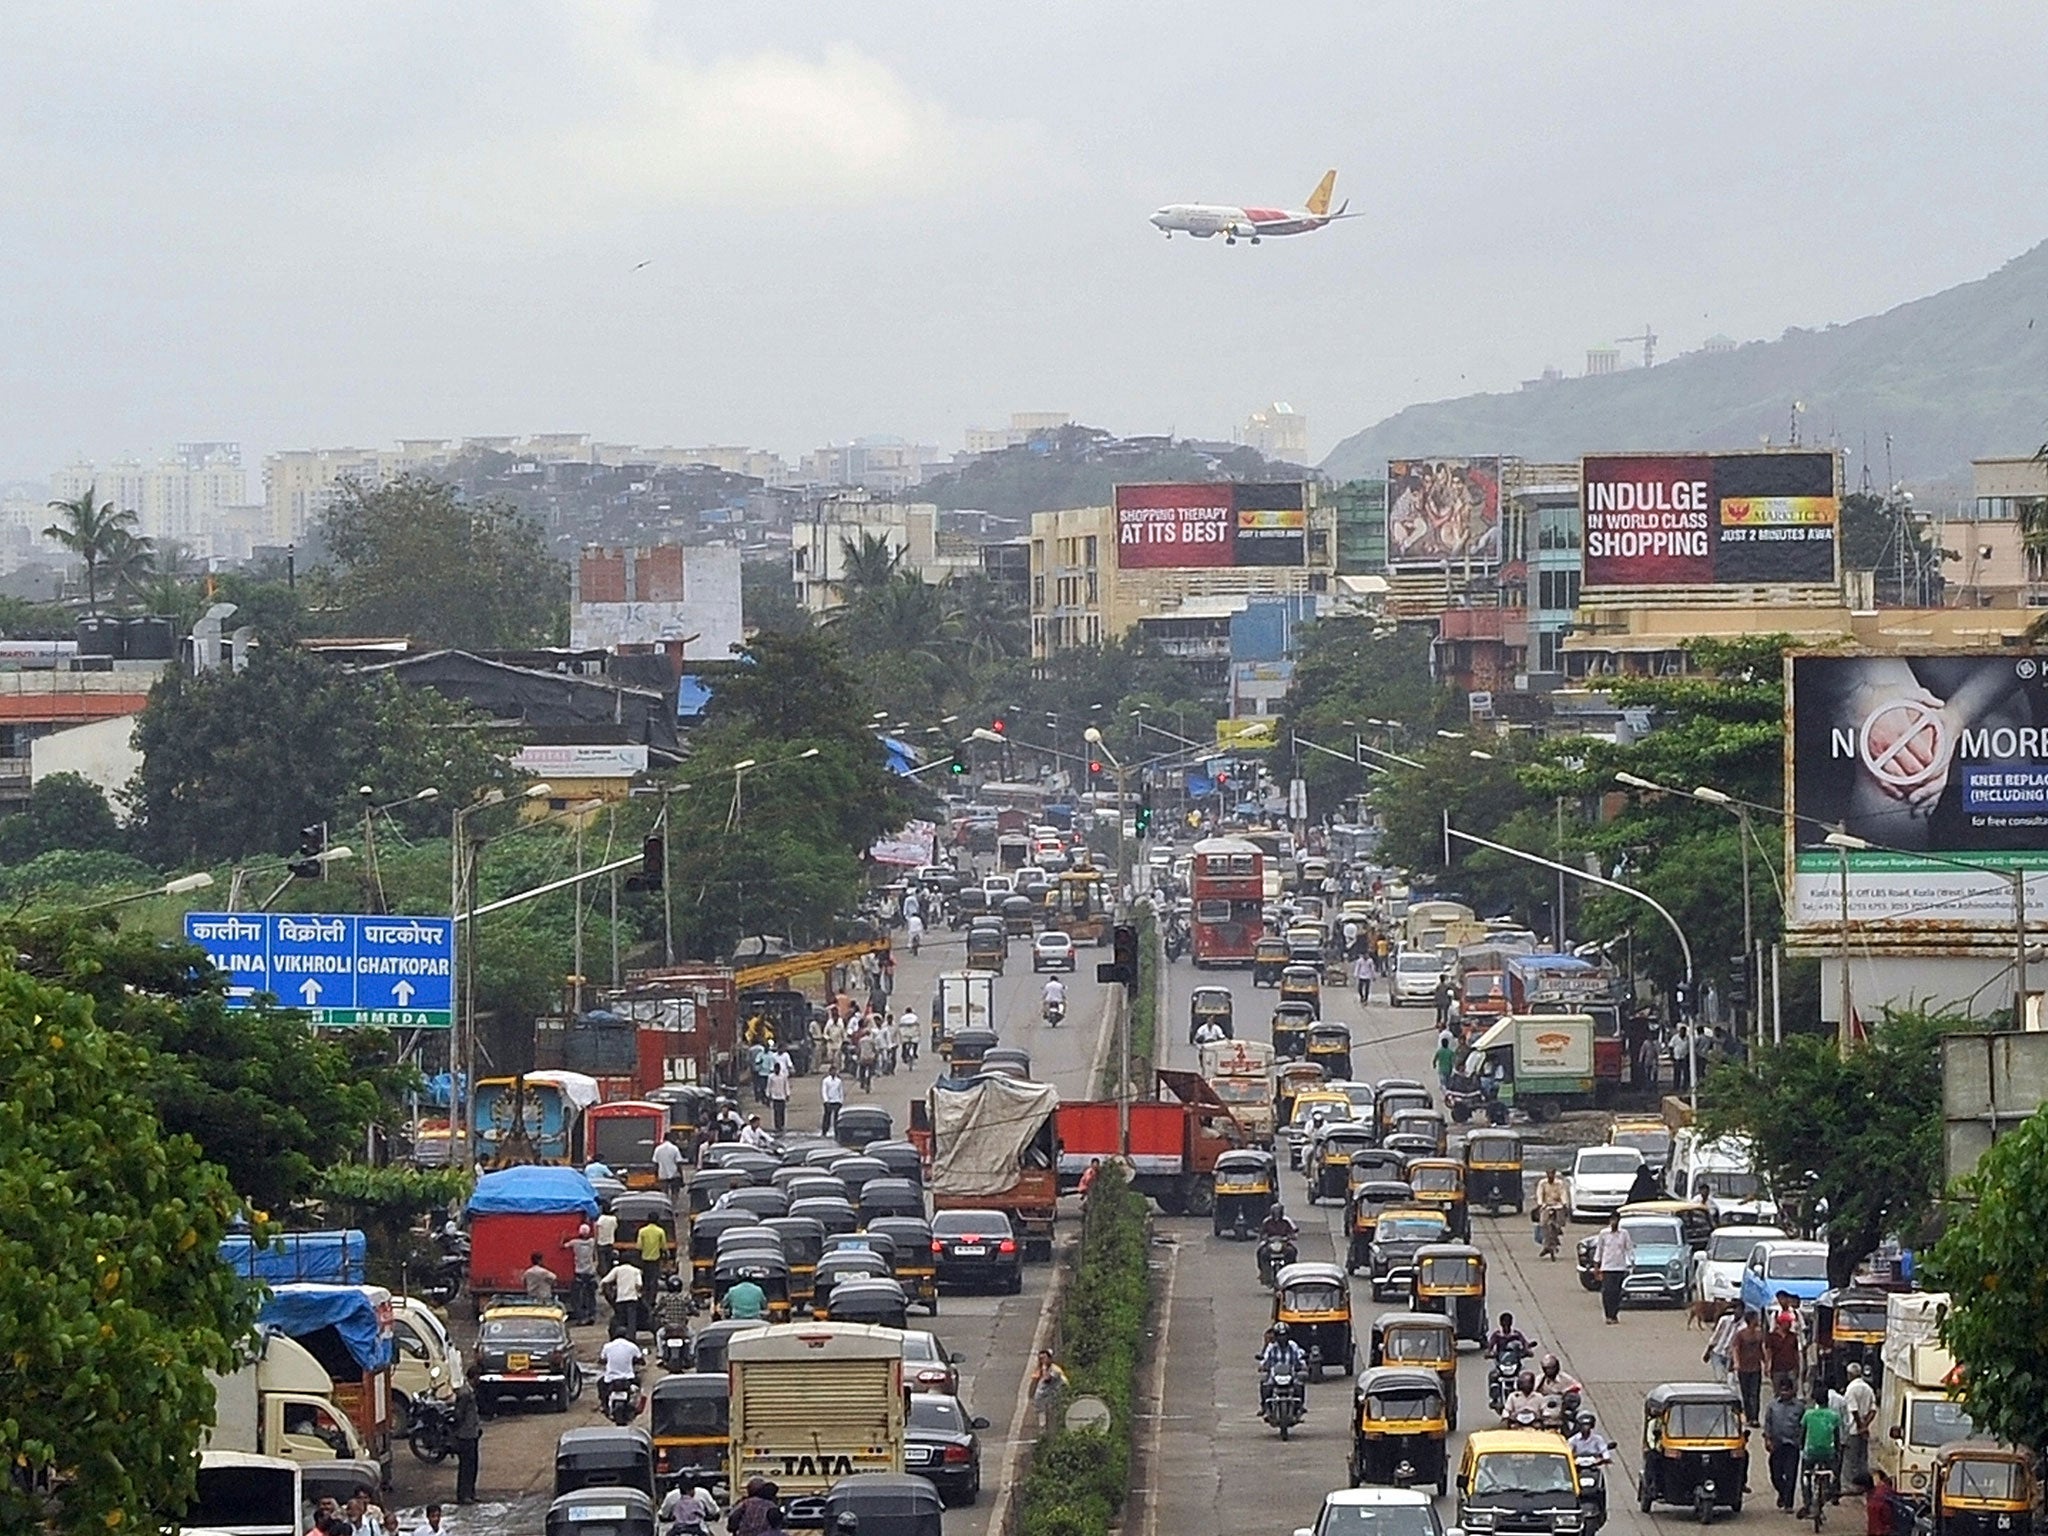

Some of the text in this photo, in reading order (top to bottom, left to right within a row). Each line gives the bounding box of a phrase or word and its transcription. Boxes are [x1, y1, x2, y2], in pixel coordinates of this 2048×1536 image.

[1588, 481, 1708, 511] INDULGE
[1588, 512, 1708, 529] IN WORLD CLASS
[1121, 522, 1228, 544] AT ITS BEST
[1720, 529, 1747, 541] JUST
[1749, 529, 1757, 540] 2
[1758, 529, 1805, 541] MINUTES
[1588, 531, 1708, 557] SHOPPING
[1970, 774, 2003, 787] KNEE
[1972, 816, 1985, 826] for
[1987, 816, 2007, 826] free
[192, 917, 261, 942] कालीना
[278, 918, 346, 943] विक्रोली
[364, 920, 444, 945] घाटकोपर
[273, 955, 351, 974] VIKHROLI
[357, 957, 449, 976] GHATKOPAR
[355, 1011, 428, 1025] MMRDA
[780, 1455, 853, 1477] TATA
